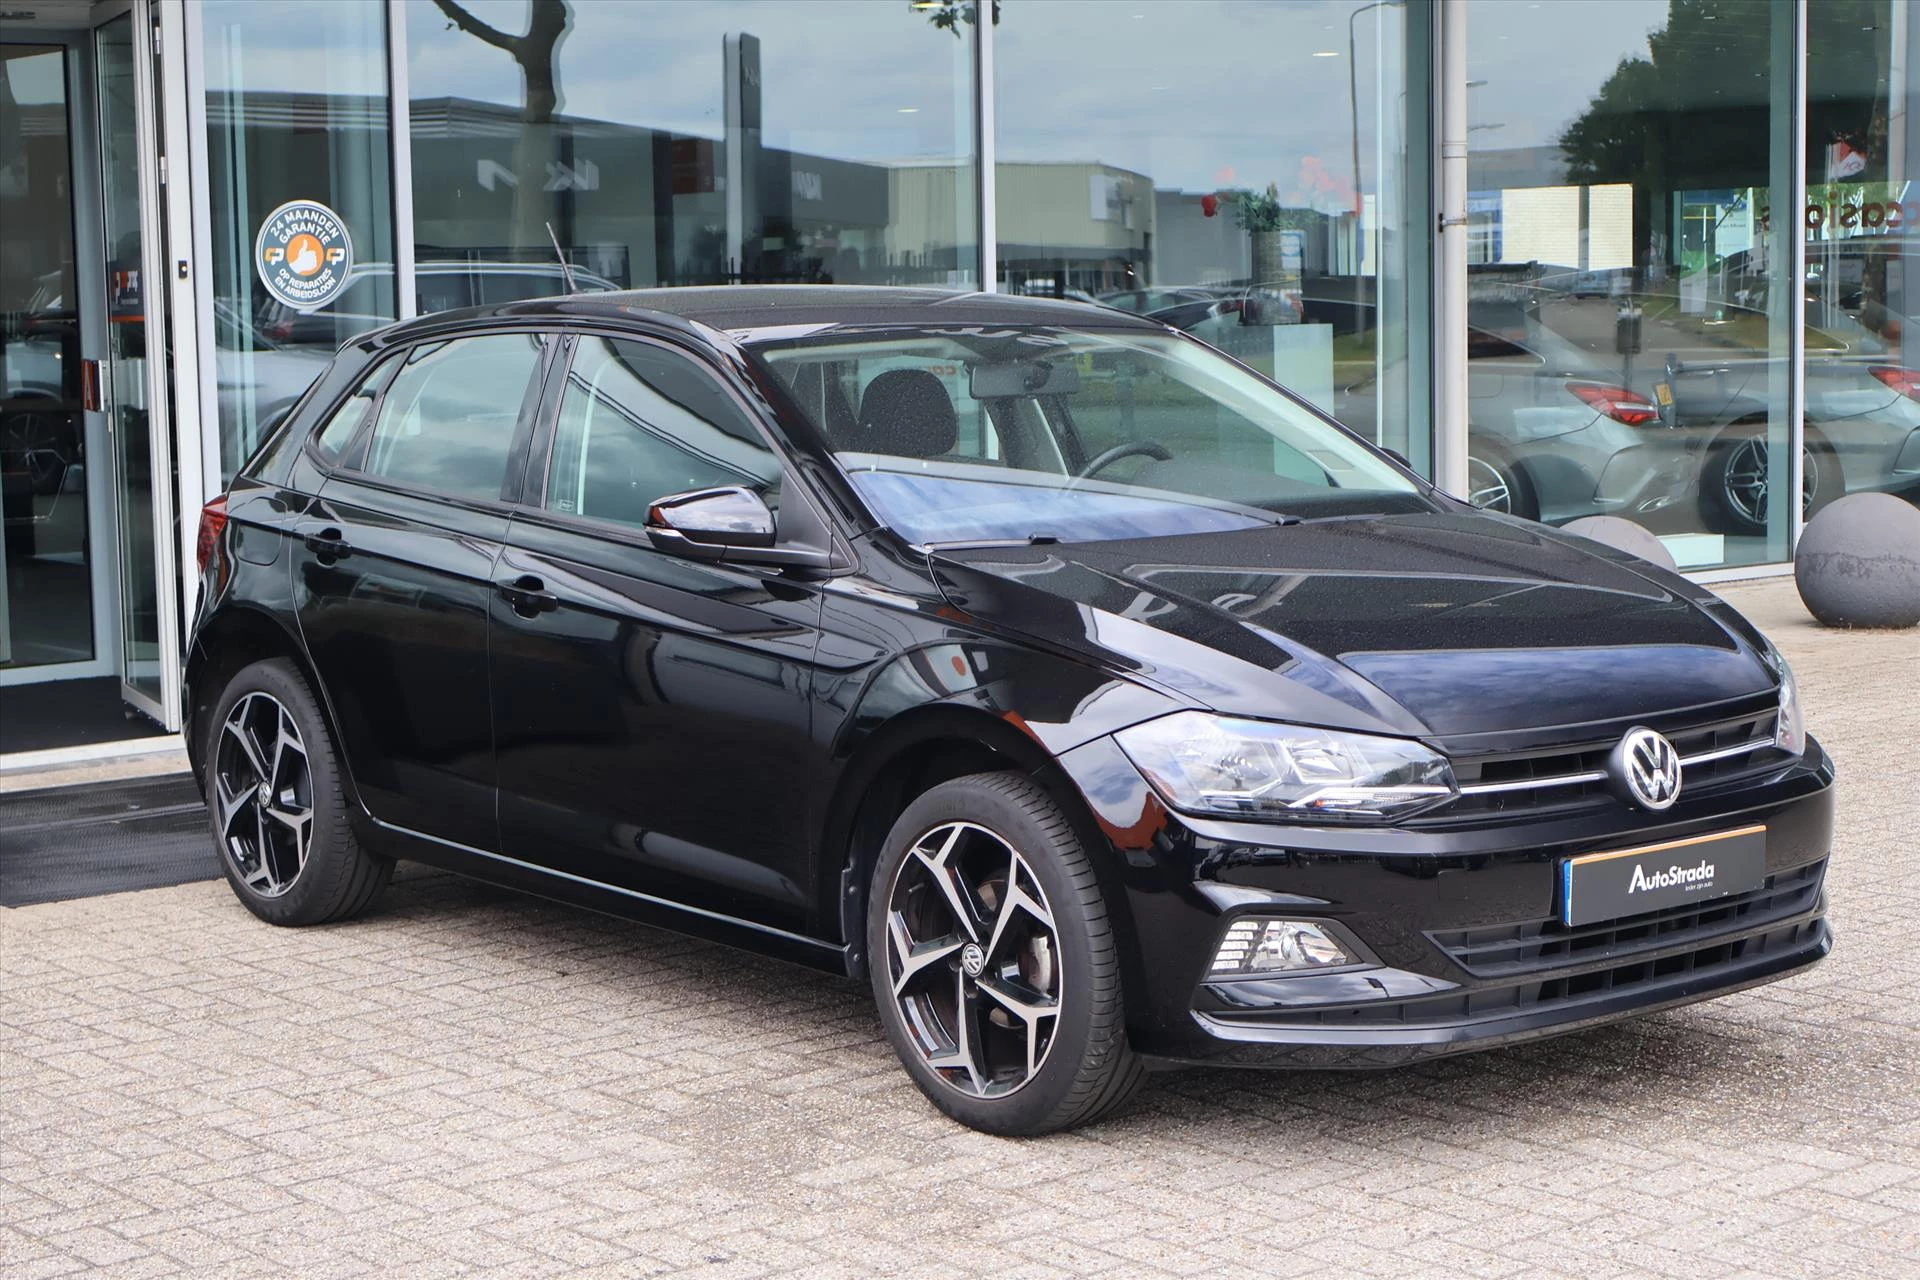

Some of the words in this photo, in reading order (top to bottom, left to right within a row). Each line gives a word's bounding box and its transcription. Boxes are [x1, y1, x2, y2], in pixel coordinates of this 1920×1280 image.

[271, 220, 284, 237] 24
[284, 209, 339, 238] MAANDEN
[279, 222, 331, 245] GARANTIE
[275, 276, 285, 289] EN
[284, 276, 336, 298] ARBEIDSLOON
[279, 268, 290, 280] OP
[289, 267, 332, 290] REPARATIES
[1628, 860, 1715, 894] AutoStrada
